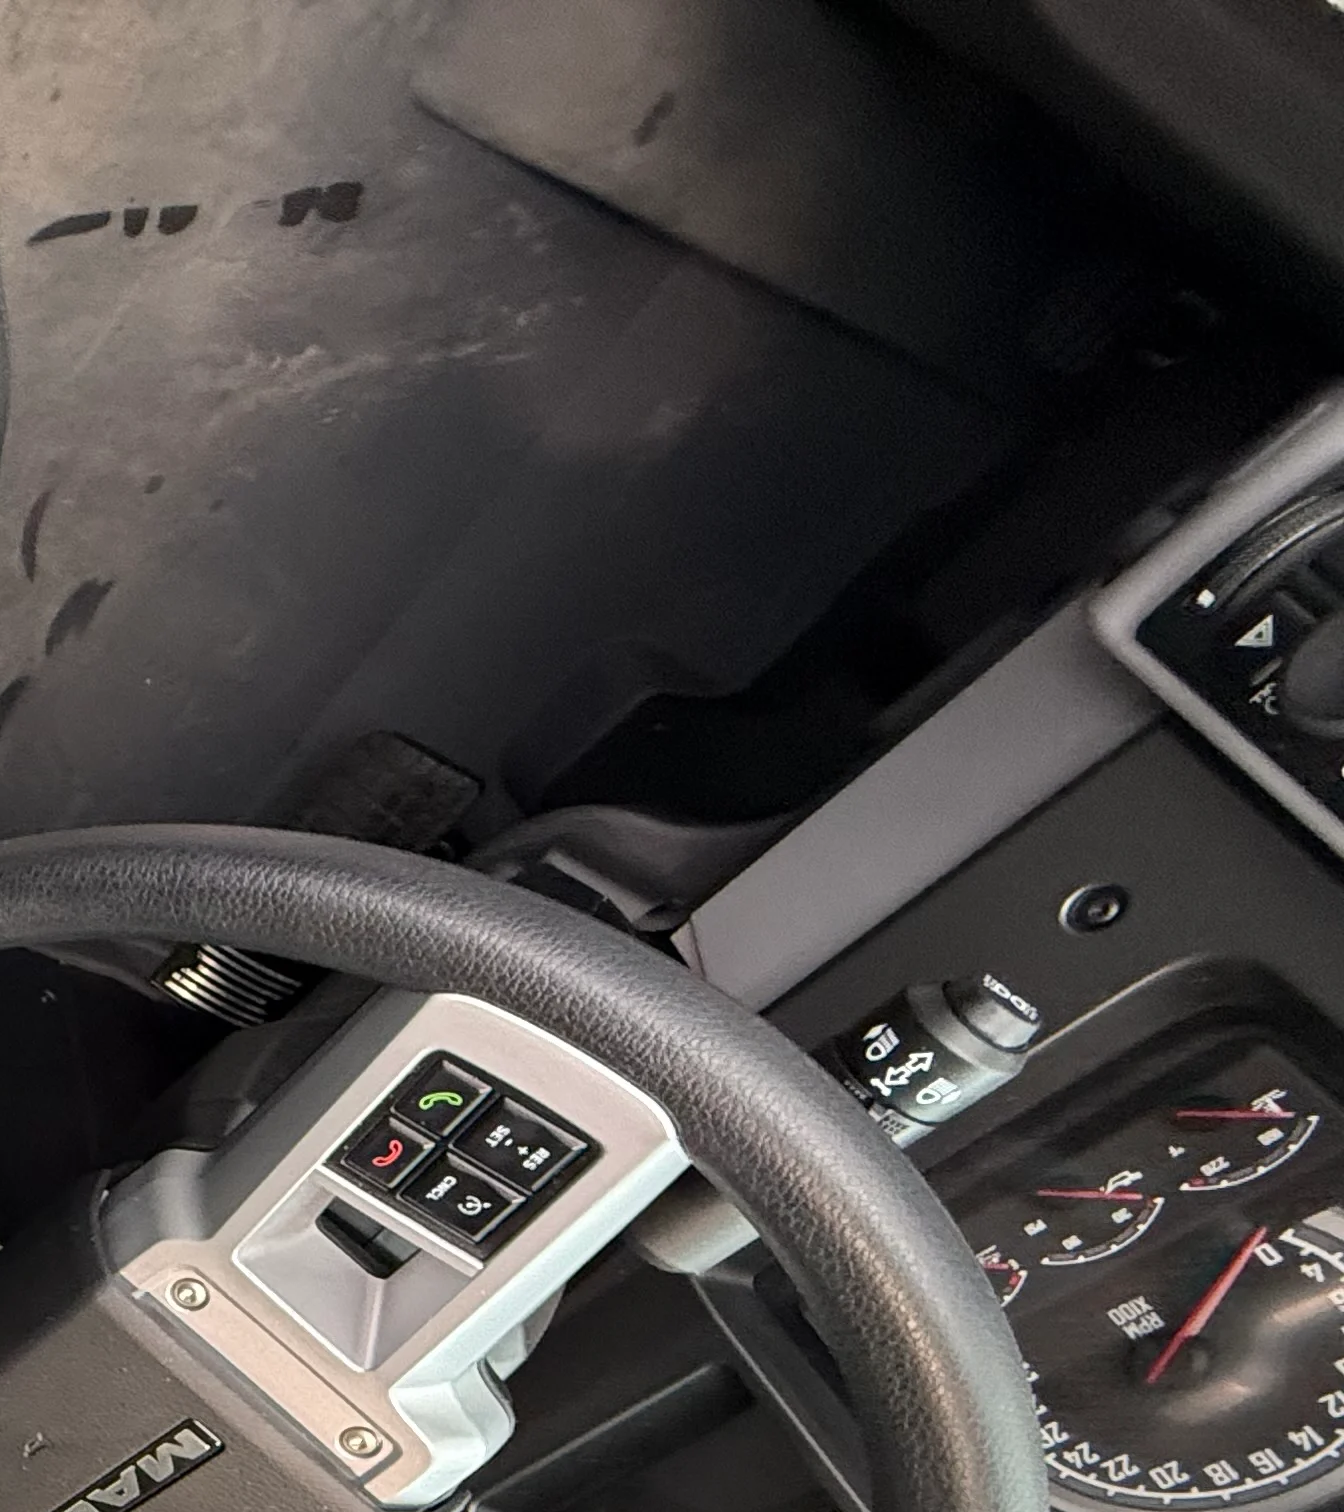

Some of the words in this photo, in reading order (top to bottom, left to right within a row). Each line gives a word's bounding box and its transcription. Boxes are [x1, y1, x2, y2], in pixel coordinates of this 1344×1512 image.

[486, 1125, 510, 1147] SET
[523, 1147, 550, 1170] RES
[425, 1176, 456, 1199] CNCL
[1299, 1262, 1325, 1282] 4
[1122, 1311, 1166, 1340] RPM
[1287, 1425, 1324, 1451] 14
[1062, 1442, 1100, 1468] 24
[1100, 1454, 1140, 1482] 22
[1247, 1448, 1285, 1475] 16
[1148, 1461, 1190, 1489] 20
[1202, 1460, 1240, 1486] 18
